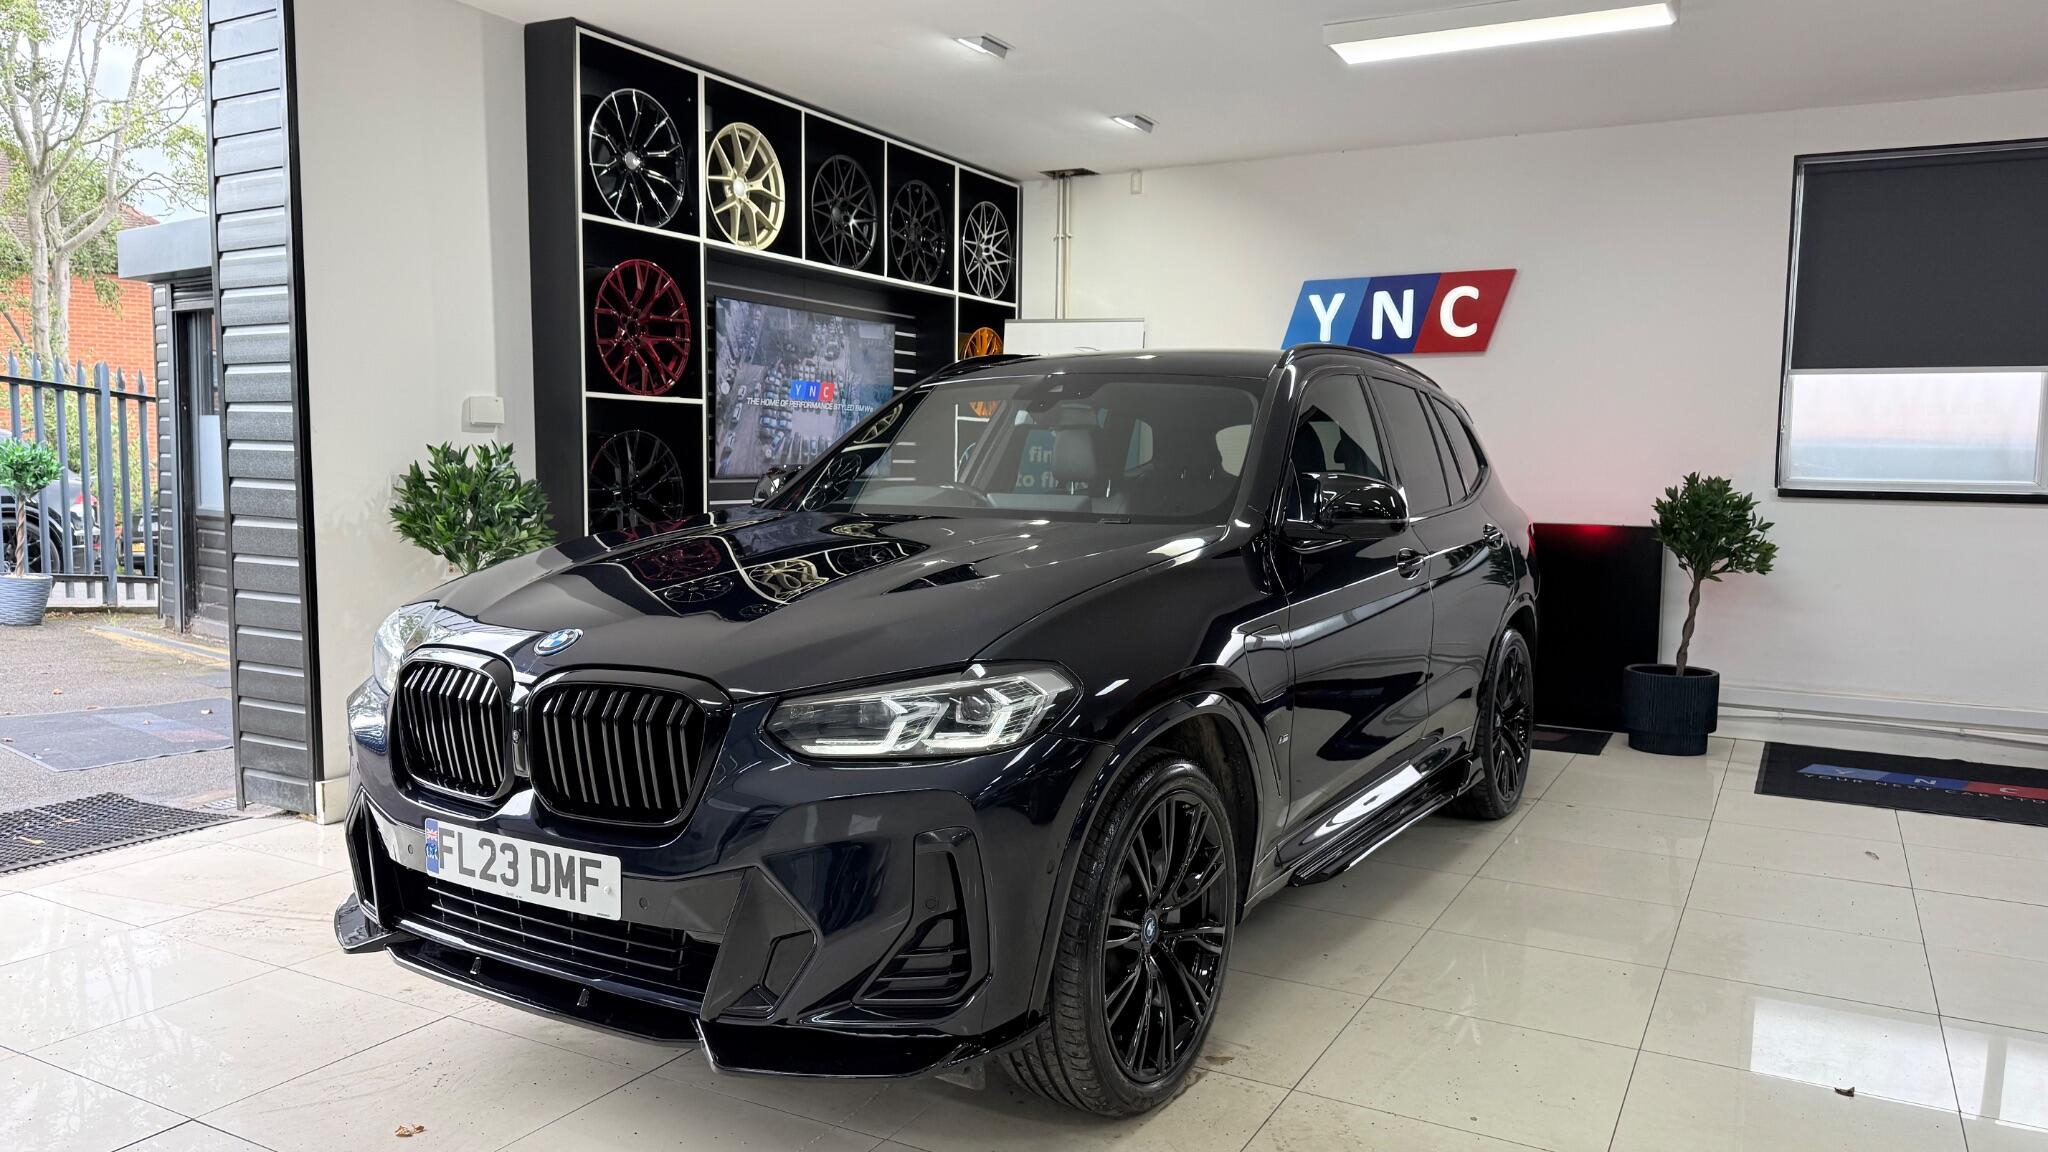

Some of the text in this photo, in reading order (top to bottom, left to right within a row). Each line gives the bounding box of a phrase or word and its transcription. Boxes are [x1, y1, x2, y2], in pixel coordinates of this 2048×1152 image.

[1308, 285, 1480, 343] YNC
[795, 384, 830, 398] YNC
[746, 396, 760, 406] THE
[760, 398, 780, 407] HOME
[780, 399, 789, 407] OF
[789, 400, 833, 411] PERFORMANCE
[834, 403, 854, 412] STYLED
[1804, 773, 1863, 784] YOUR
[1875, 781, 1931, 792] NEXT
[438, 827, 602, 903] FL23 DMF
